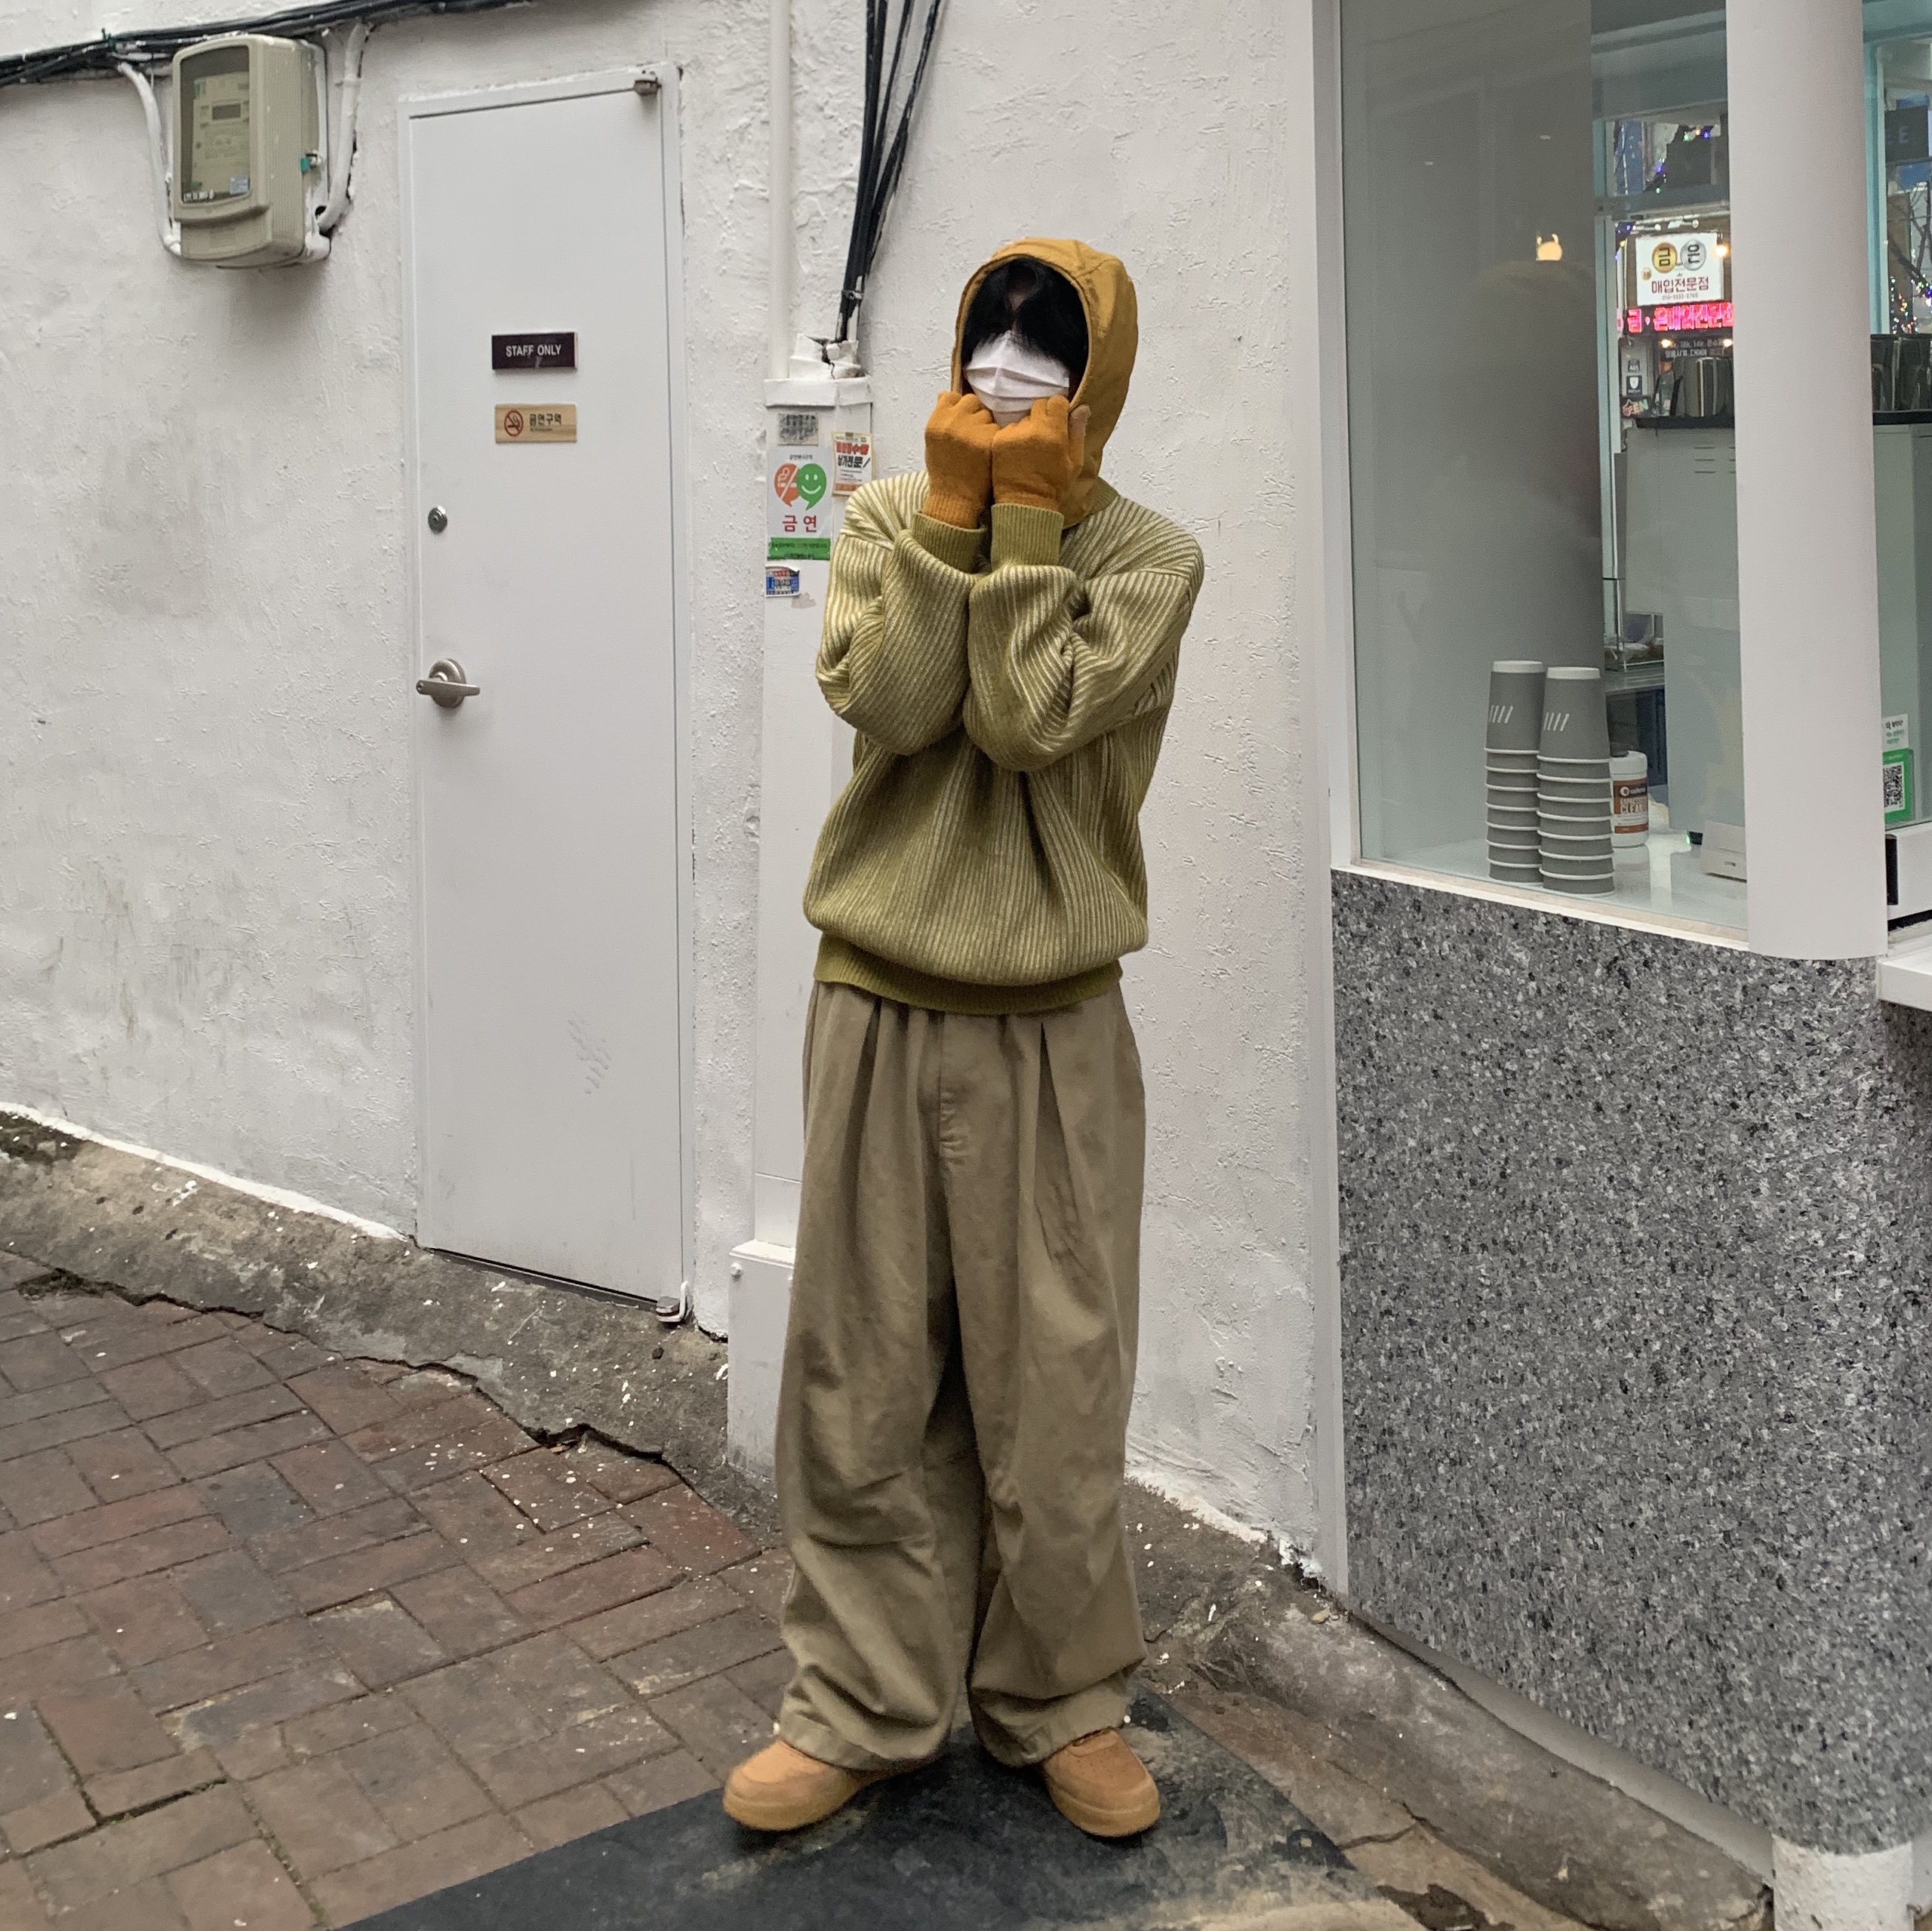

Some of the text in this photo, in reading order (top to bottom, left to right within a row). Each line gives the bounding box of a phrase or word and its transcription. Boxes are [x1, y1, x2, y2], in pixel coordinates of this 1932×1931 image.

[1658, 244, 1700, 266] 금 은
[1651, 276, 1709, 294] 매입전문점
[506, 344, 561, 358] STAFF ONLY
